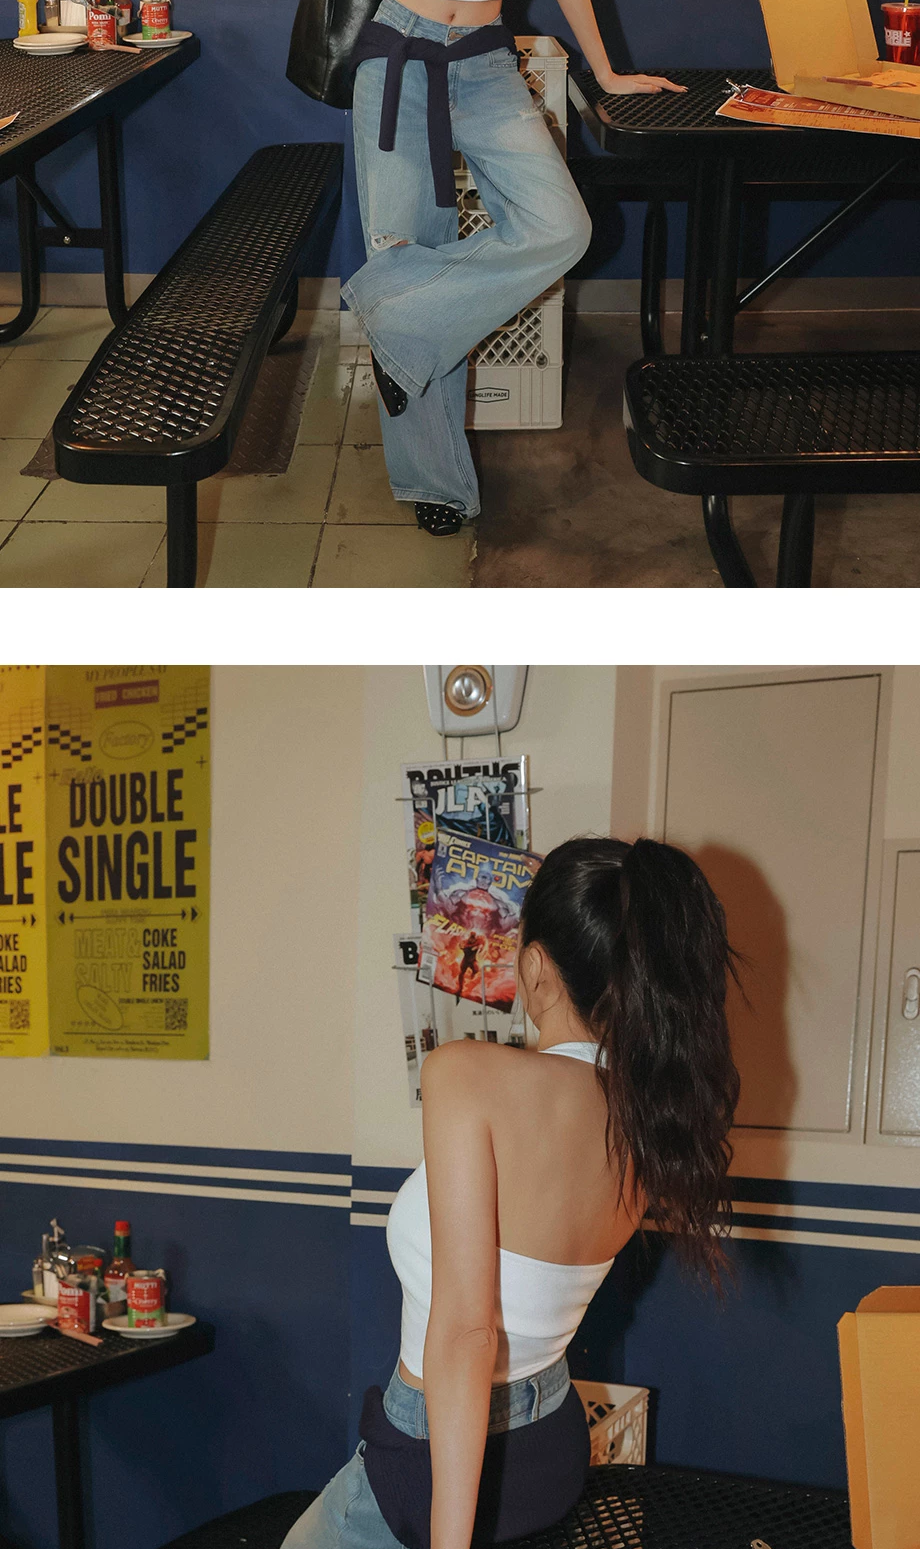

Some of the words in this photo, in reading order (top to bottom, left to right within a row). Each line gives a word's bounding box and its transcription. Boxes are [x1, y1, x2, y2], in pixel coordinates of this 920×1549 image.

[70, 769, 183, 828] DOUBLE
[435, 785, 490, 815] JLA
[58, 829, 197, 903] SINGLE
[448, 846, 536, 878] CAPTAIN
[143, 928, 177, 947] COKE
[143, 951, 186, 970] SALAD
[143, 973, 180, 992] FRIES
